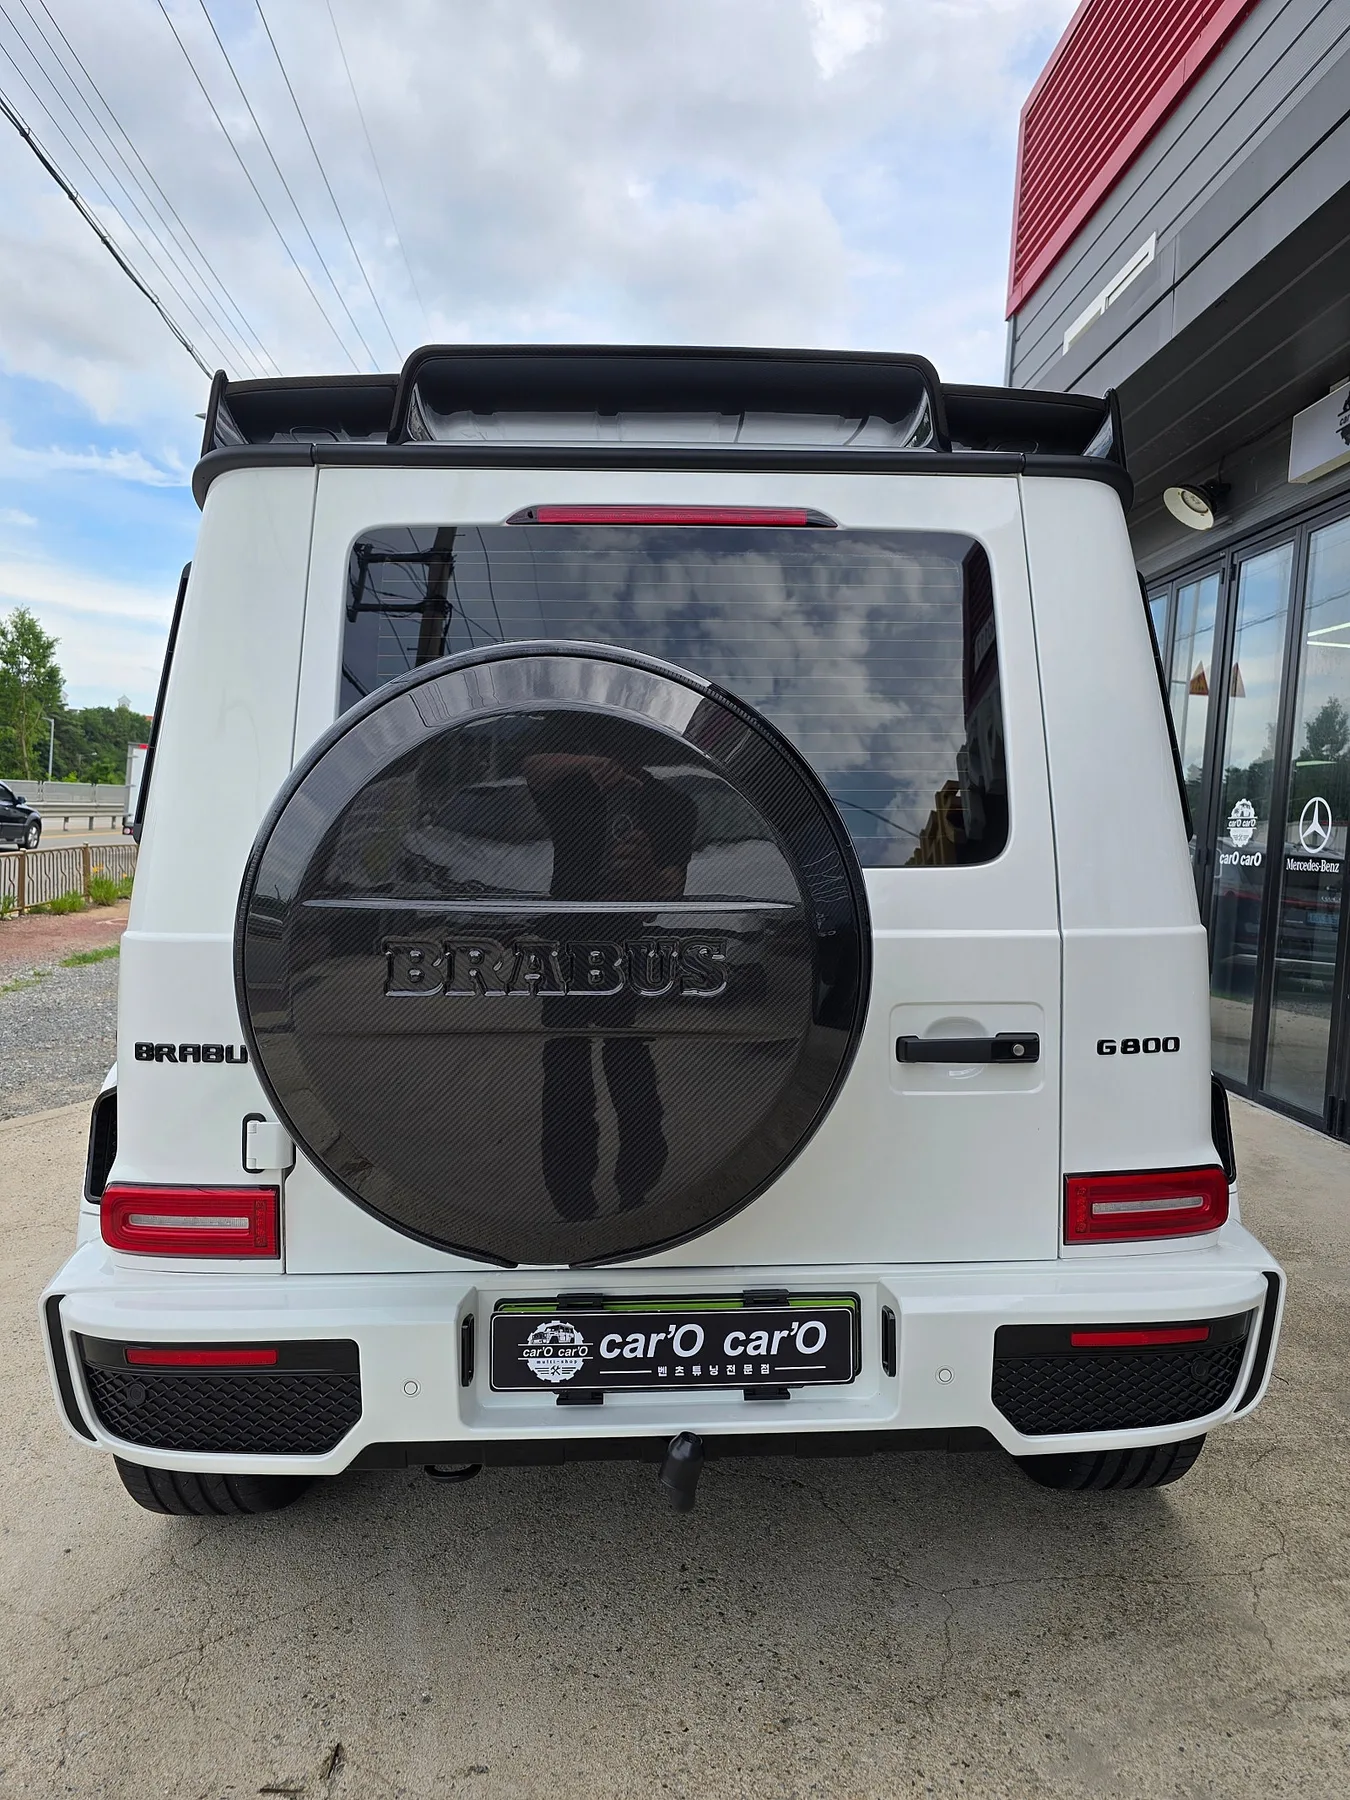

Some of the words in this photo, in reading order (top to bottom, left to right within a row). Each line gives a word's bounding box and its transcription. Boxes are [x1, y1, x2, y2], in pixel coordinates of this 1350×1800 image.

[1286, 858, 1340, 873] Mercedes-Benz
[382, 936, 728, 997] BRABUS
[134, 1042, 250, 1063] BRABU
[1097, 1037, 1180, 1055] G800
[599, 1323, 705, 1359] car'O
[723, 1320, 827, 1357] car'O
[523, 1346, 553, 1357] car'O
[558, 1346, 588, 1356] car'O
